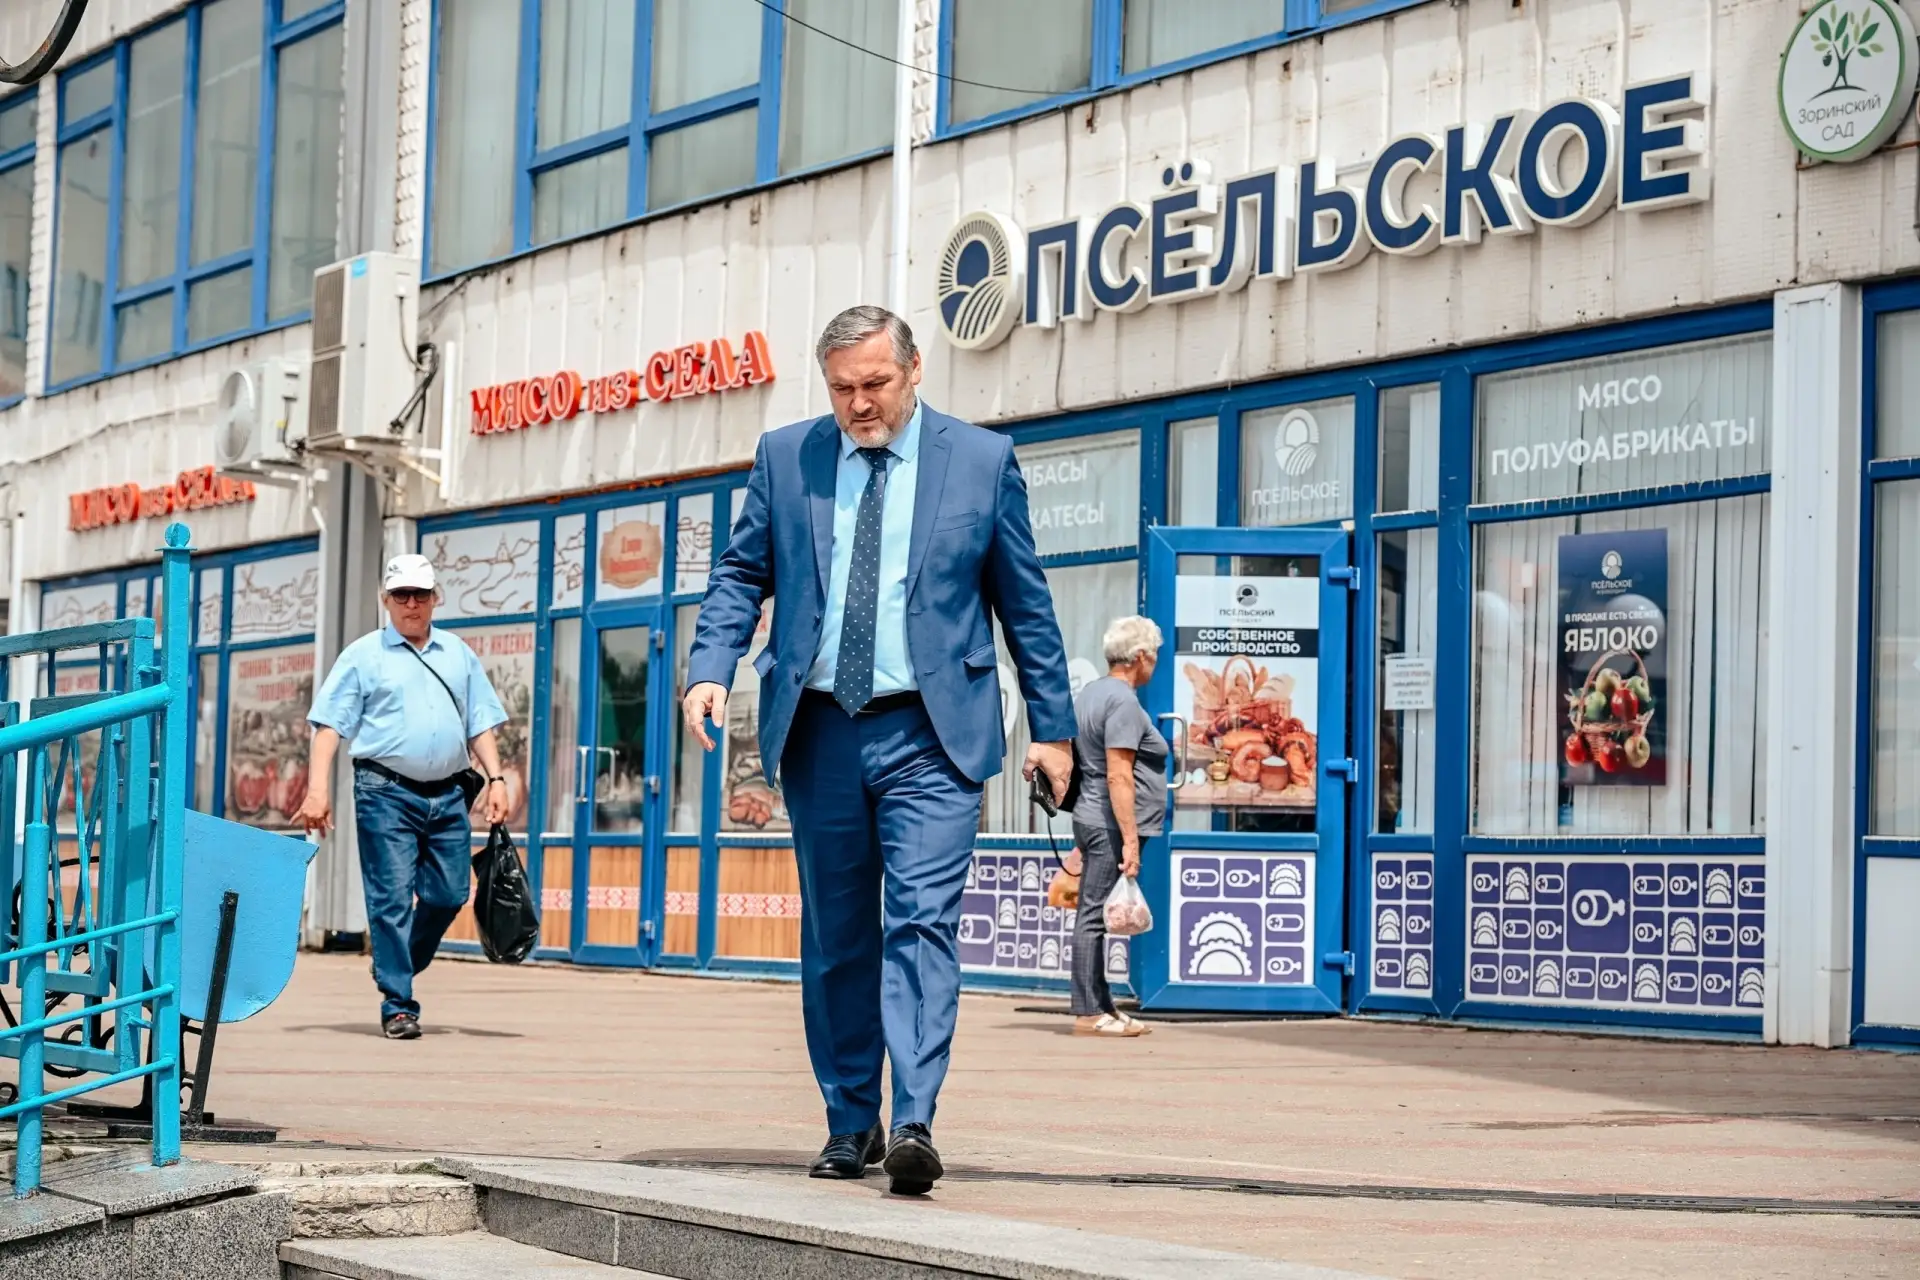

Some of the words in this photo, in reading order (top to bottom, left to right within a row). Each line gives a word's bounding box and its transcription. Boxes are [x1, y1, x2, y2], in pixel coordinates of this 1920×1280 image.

[1821, 121, 1854, 141] САД
[1024, 73, 1706, 330] ПСЁЛЬСКОЕ
[471, 370, 583, 436] МЯСО
[645, 329, 776, 404] СЕЛА
[1577, 374, 1662, 412] МЯСО
[1491, 416, 1756, 476] ПОЛУФАБРИКАТЫ
[1022, 459, 1088, 488] ЛБАСЫ
[1030, 501, 1105, 530] КАТЕСЫ
[1564, 613, 1571, 623] В
[1571, 611, 1608, 622] ПРОДАЖЕ
[1608, 610, 1628, 620] ЕСТЬ
[1191, 641, 1302, 655] ПРОИЗВОДСТВО
[1197, 629, 1296, 642] СОБСТВЕННОЕ
[1564, 624, 1659, 653] ЯБЛОКО
